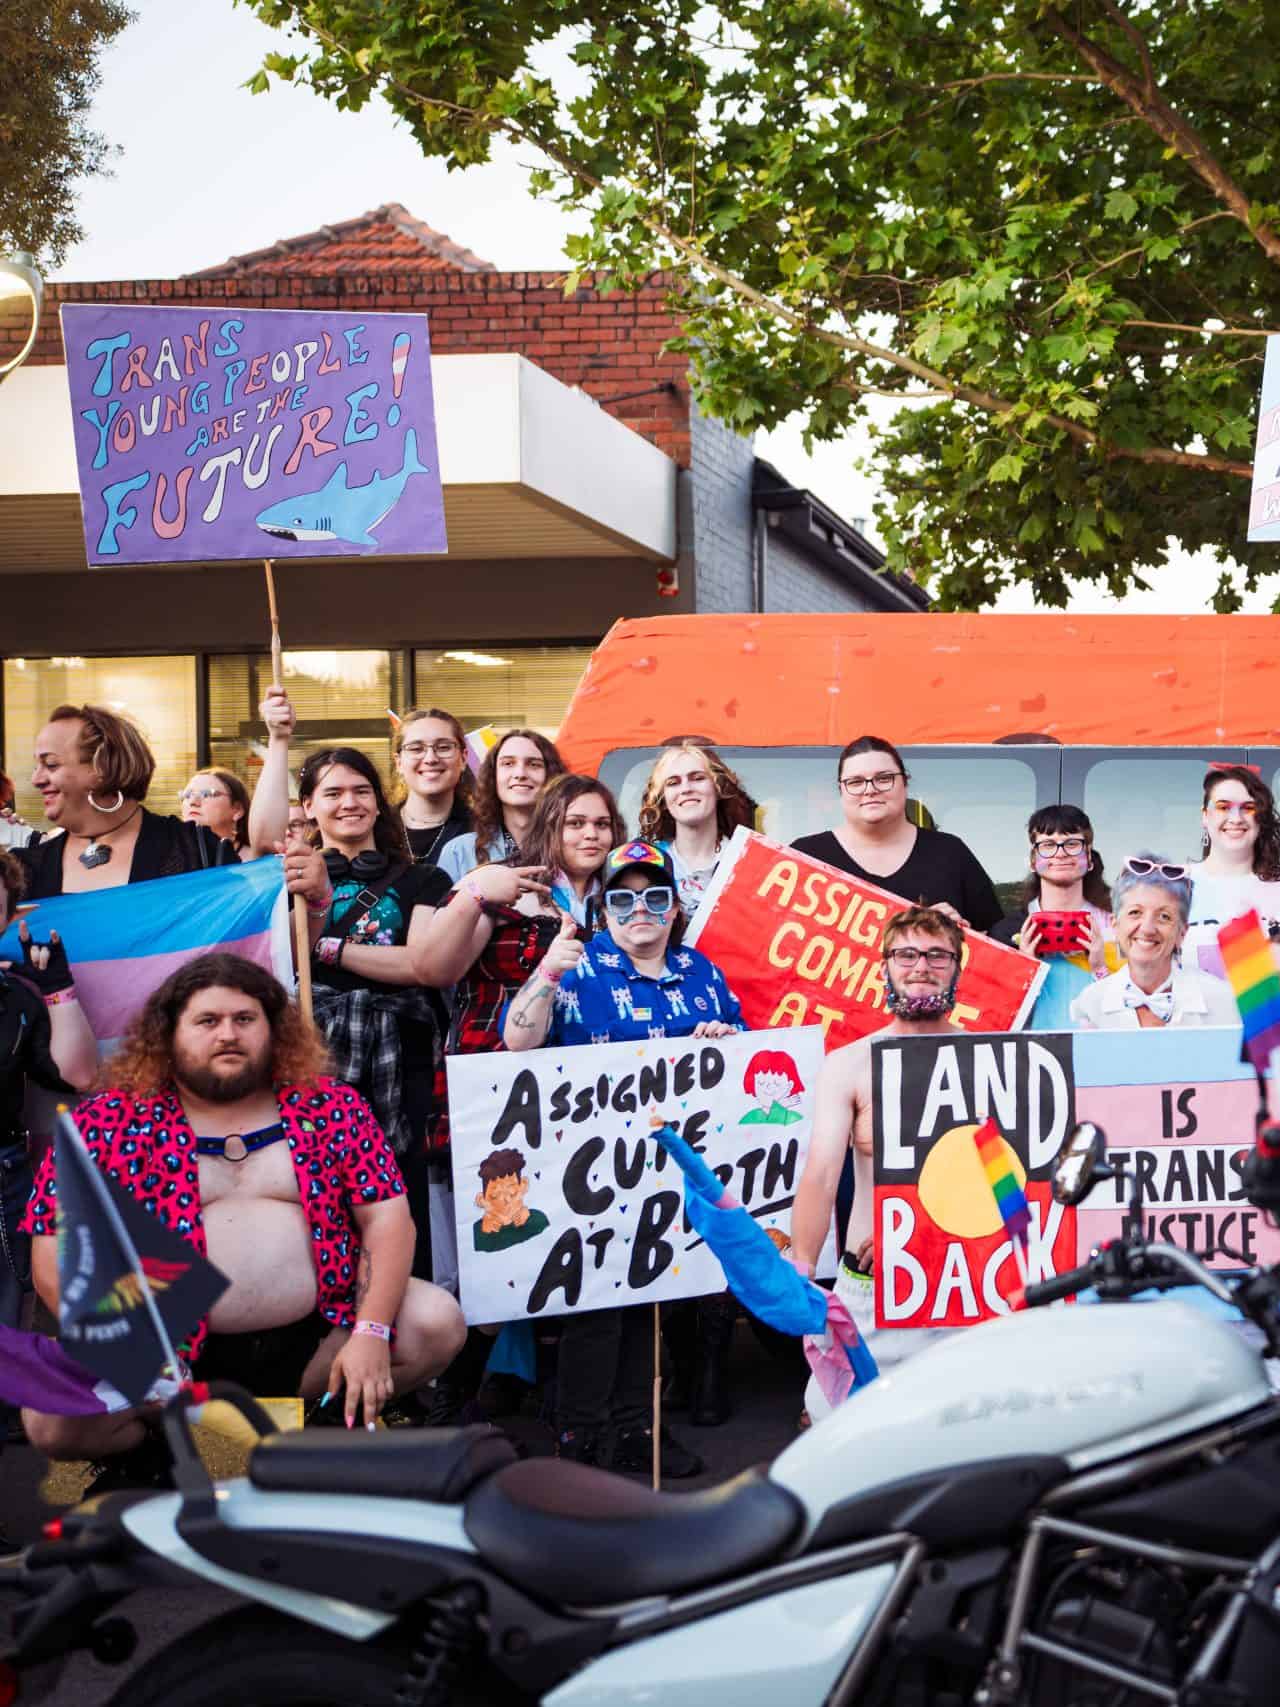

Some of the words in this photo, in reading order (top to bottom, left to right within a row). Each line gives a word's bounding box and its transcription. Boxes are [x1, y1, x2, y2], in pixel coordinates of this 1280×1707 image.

[81, 382, 211, 470] YOUNG
[223, 324, 369, 407] PEOPLE
[86, 320, 245, 398] TRANS
[95, 332, 412, 554] FUTURE!
[185, 409, 247, 456] ARE
[256, 385, 309, 425] THE
[491, 1047, 725, 1149] ASSIGNED
[881, 1040, 1069, 1171] LAND
[1161, 1088, 1198, 1138] IS
[527, 1227, 615, 1314] AT
